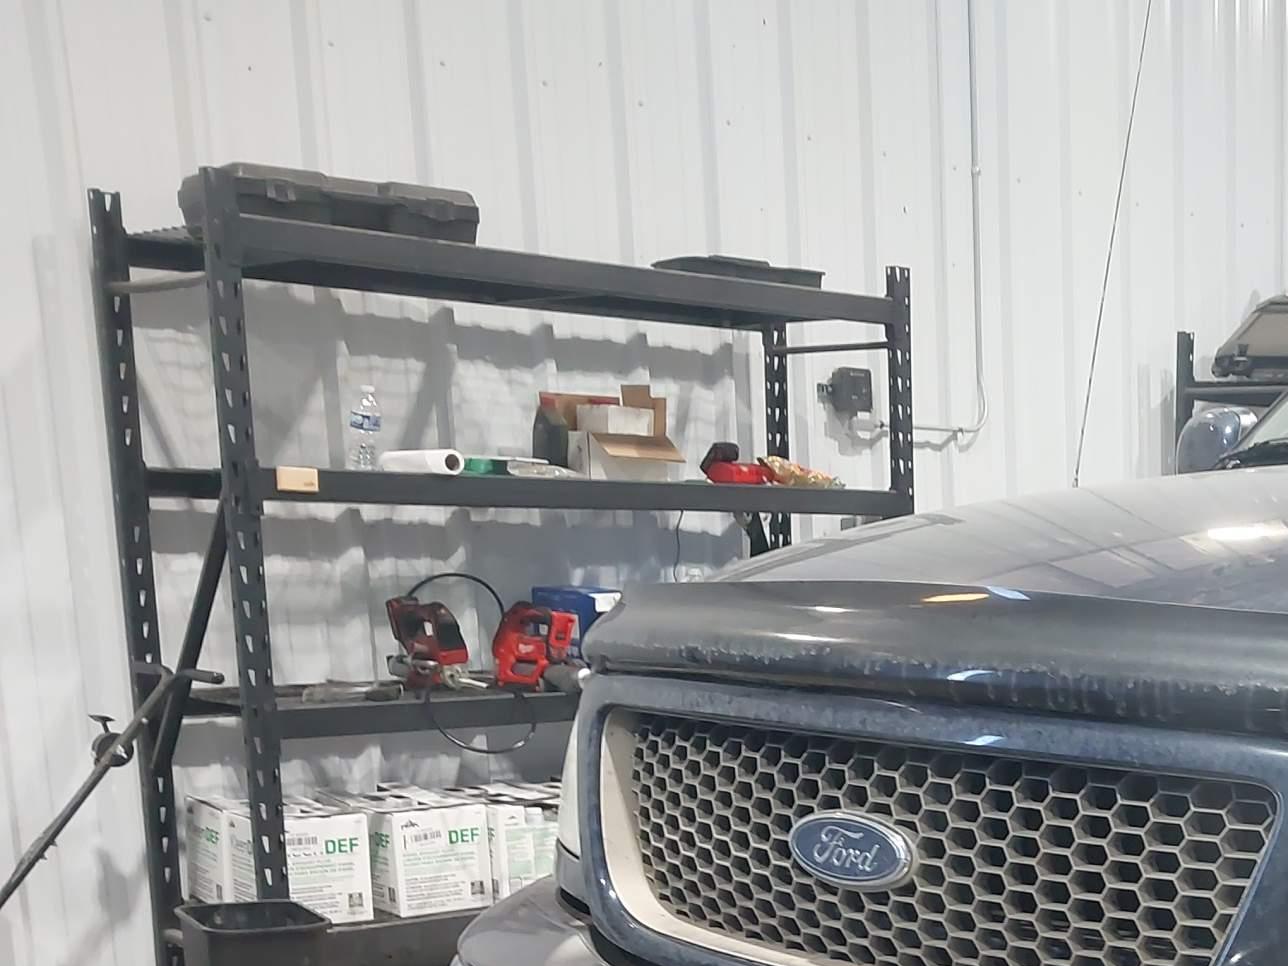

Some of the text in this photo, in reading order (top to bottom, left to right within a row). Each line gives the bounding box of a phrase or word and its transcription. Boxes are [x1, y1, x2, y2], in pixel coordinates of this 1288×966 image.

[448, 827, 480, 845] DEF
[325, 837, 359, 855] DEF
[812, 825, 881, 873] Ford
